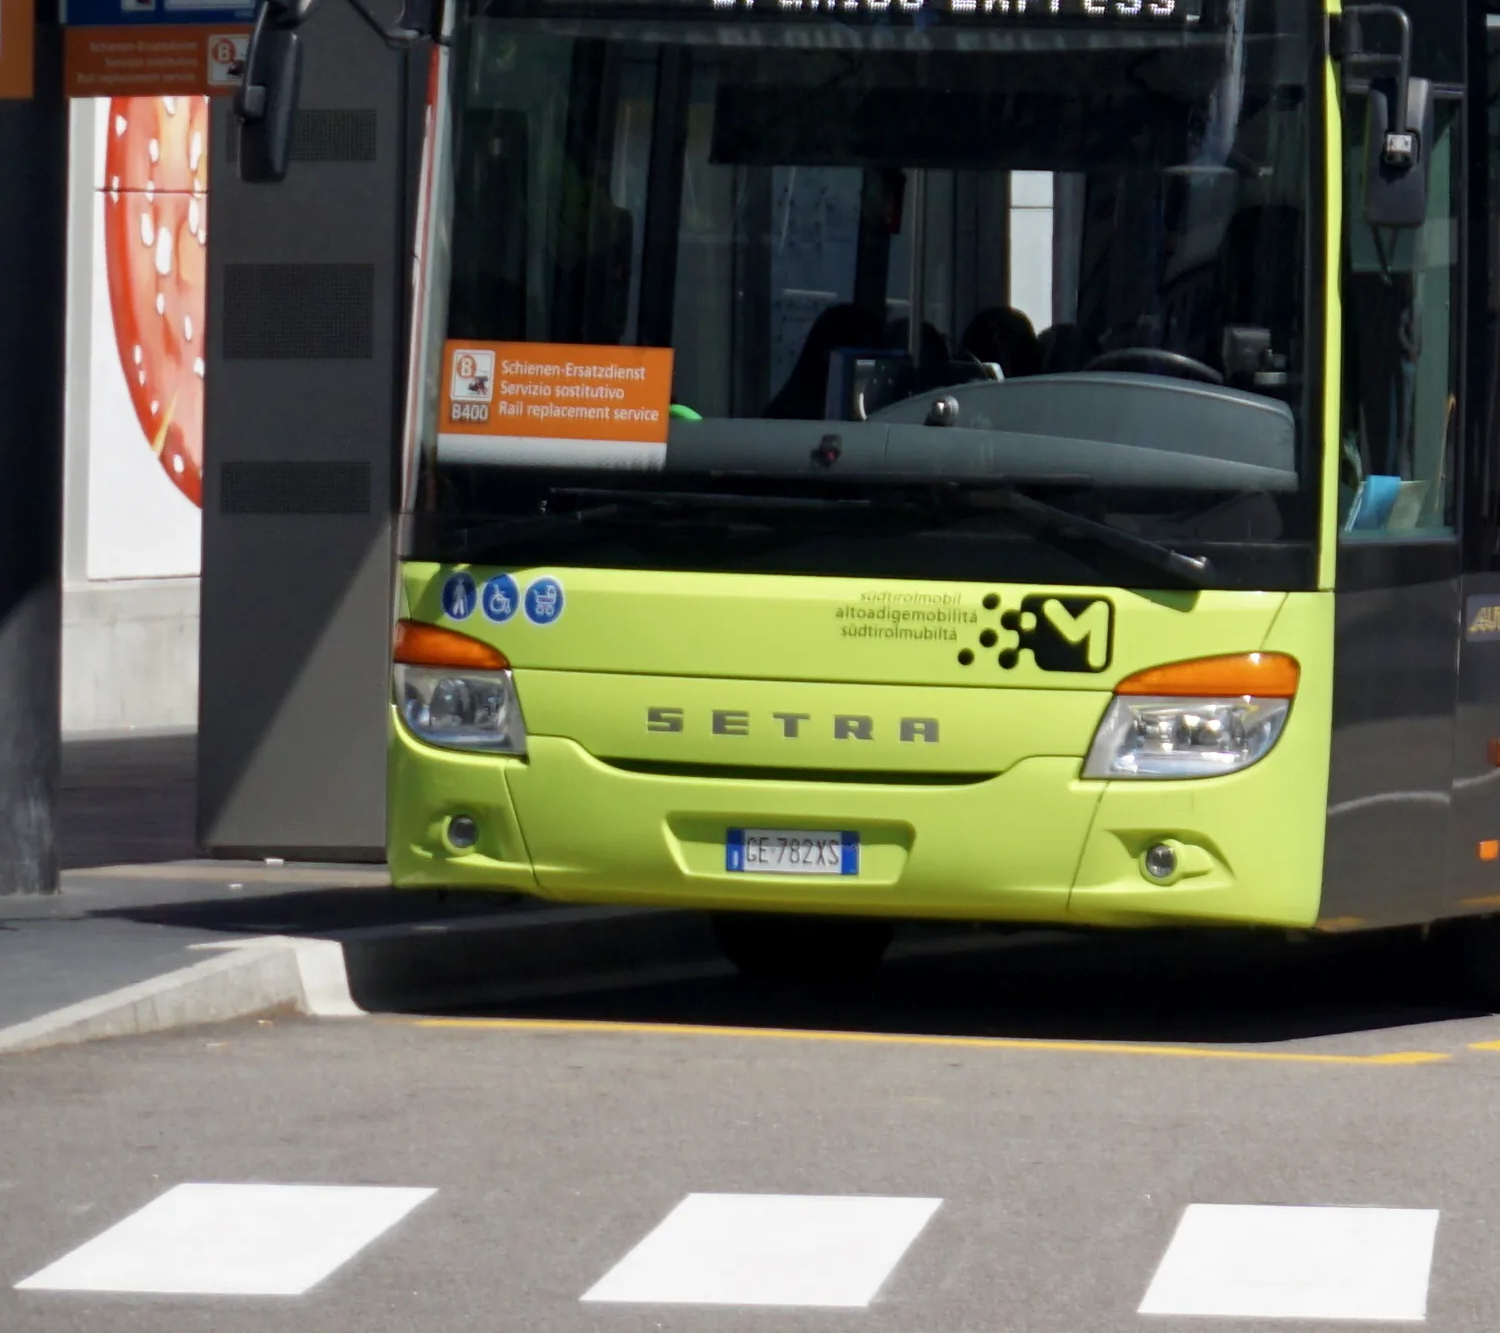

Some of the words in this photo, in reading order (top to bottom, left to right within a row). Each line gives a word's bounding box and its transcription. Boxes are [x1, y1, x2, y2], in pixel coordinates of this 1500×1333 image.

[502, 360, 646, 380] Schienen-Ersatzdienst
[501, 380, 552, 397] Servizio
[556, 384, 625, 400] sostitutivo
[451, 404, 489, 422] B400
[499, 400, 524, 416] Rail
[528, 404, 610, 422] replacement
[614, 407, 660, 422] service
[860, 590, 962, 605] südtirolmobil
[647, 706, 940, 743] SETRA
